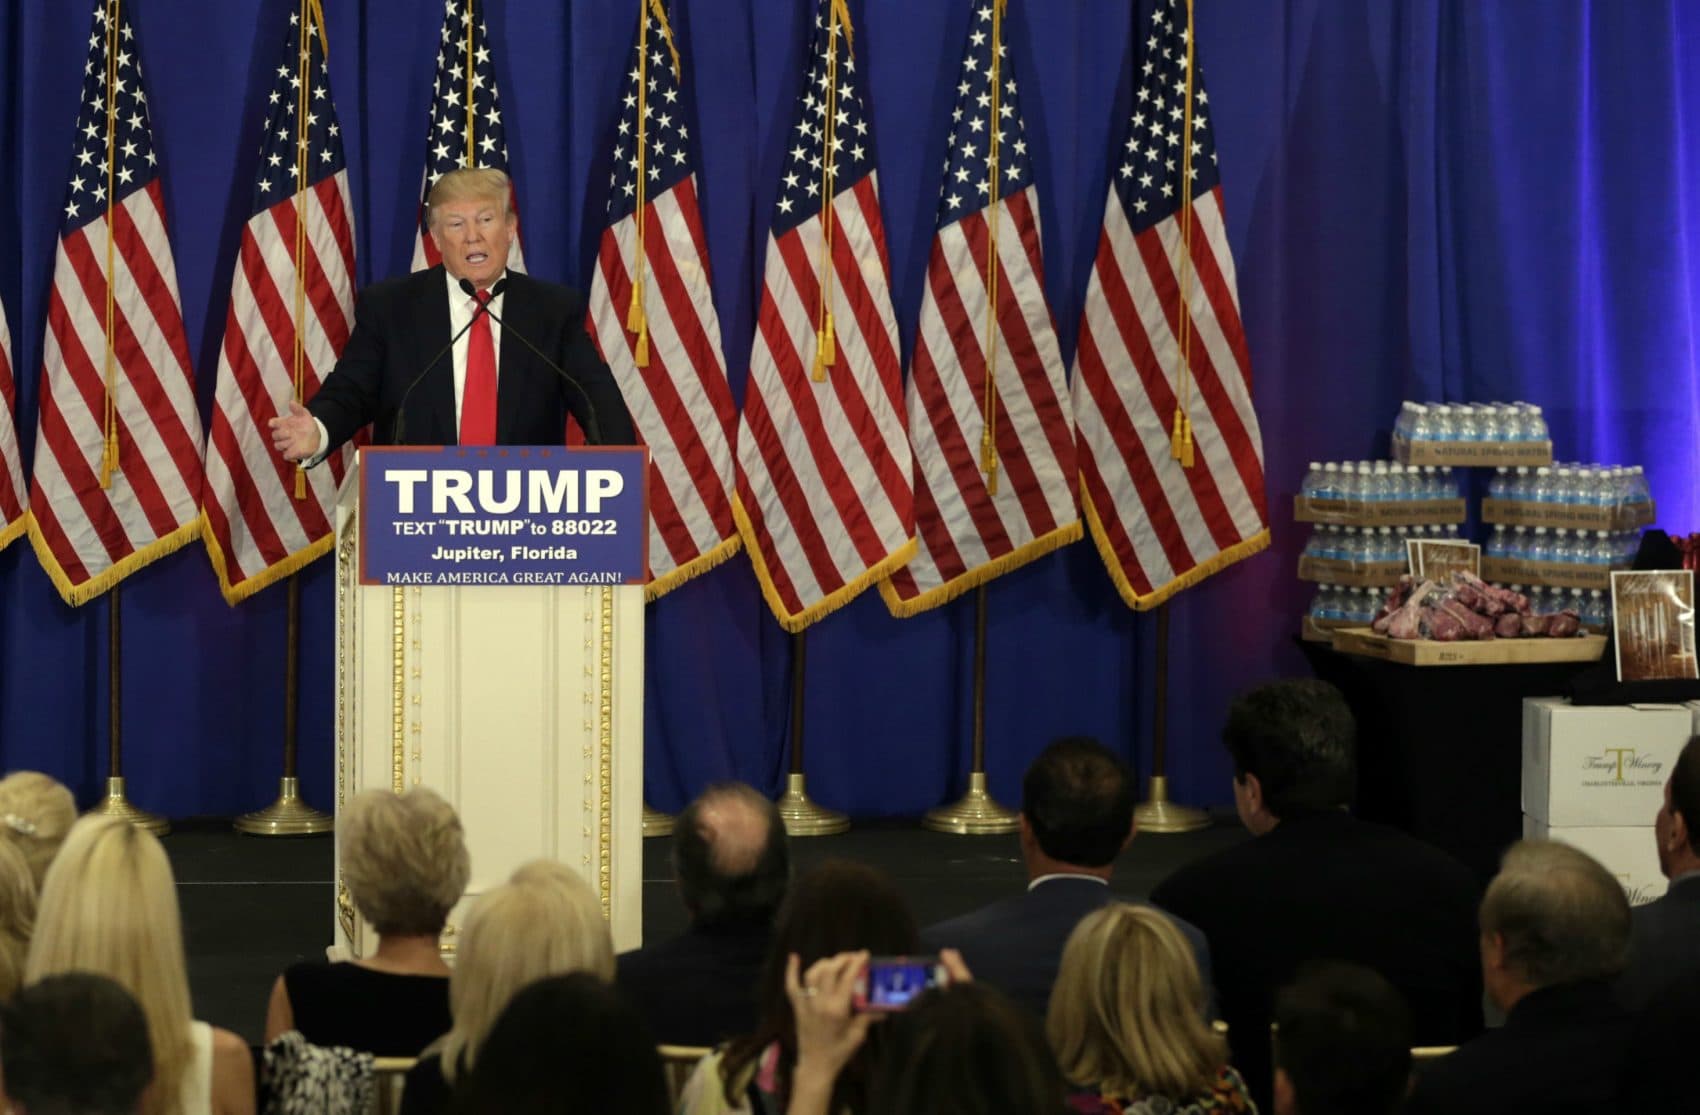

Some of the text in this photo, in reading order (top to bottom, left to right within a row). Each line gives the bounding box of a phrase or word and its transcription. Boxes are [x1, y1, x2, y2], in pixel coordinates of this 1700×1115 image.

[385, 469, 624, 514] TRUMP
[392, 521, 436, 535] TEXT
[531, 522, 547, 535] to
[551, 519, 617, 535] 88022
[431, 546, 577, 563] Jupiter, Florida
[386, 571, 622, 584] MAKE AMERICA GREAT AGAIN!
[1582, 753, 1663, 775] Trump Winery
